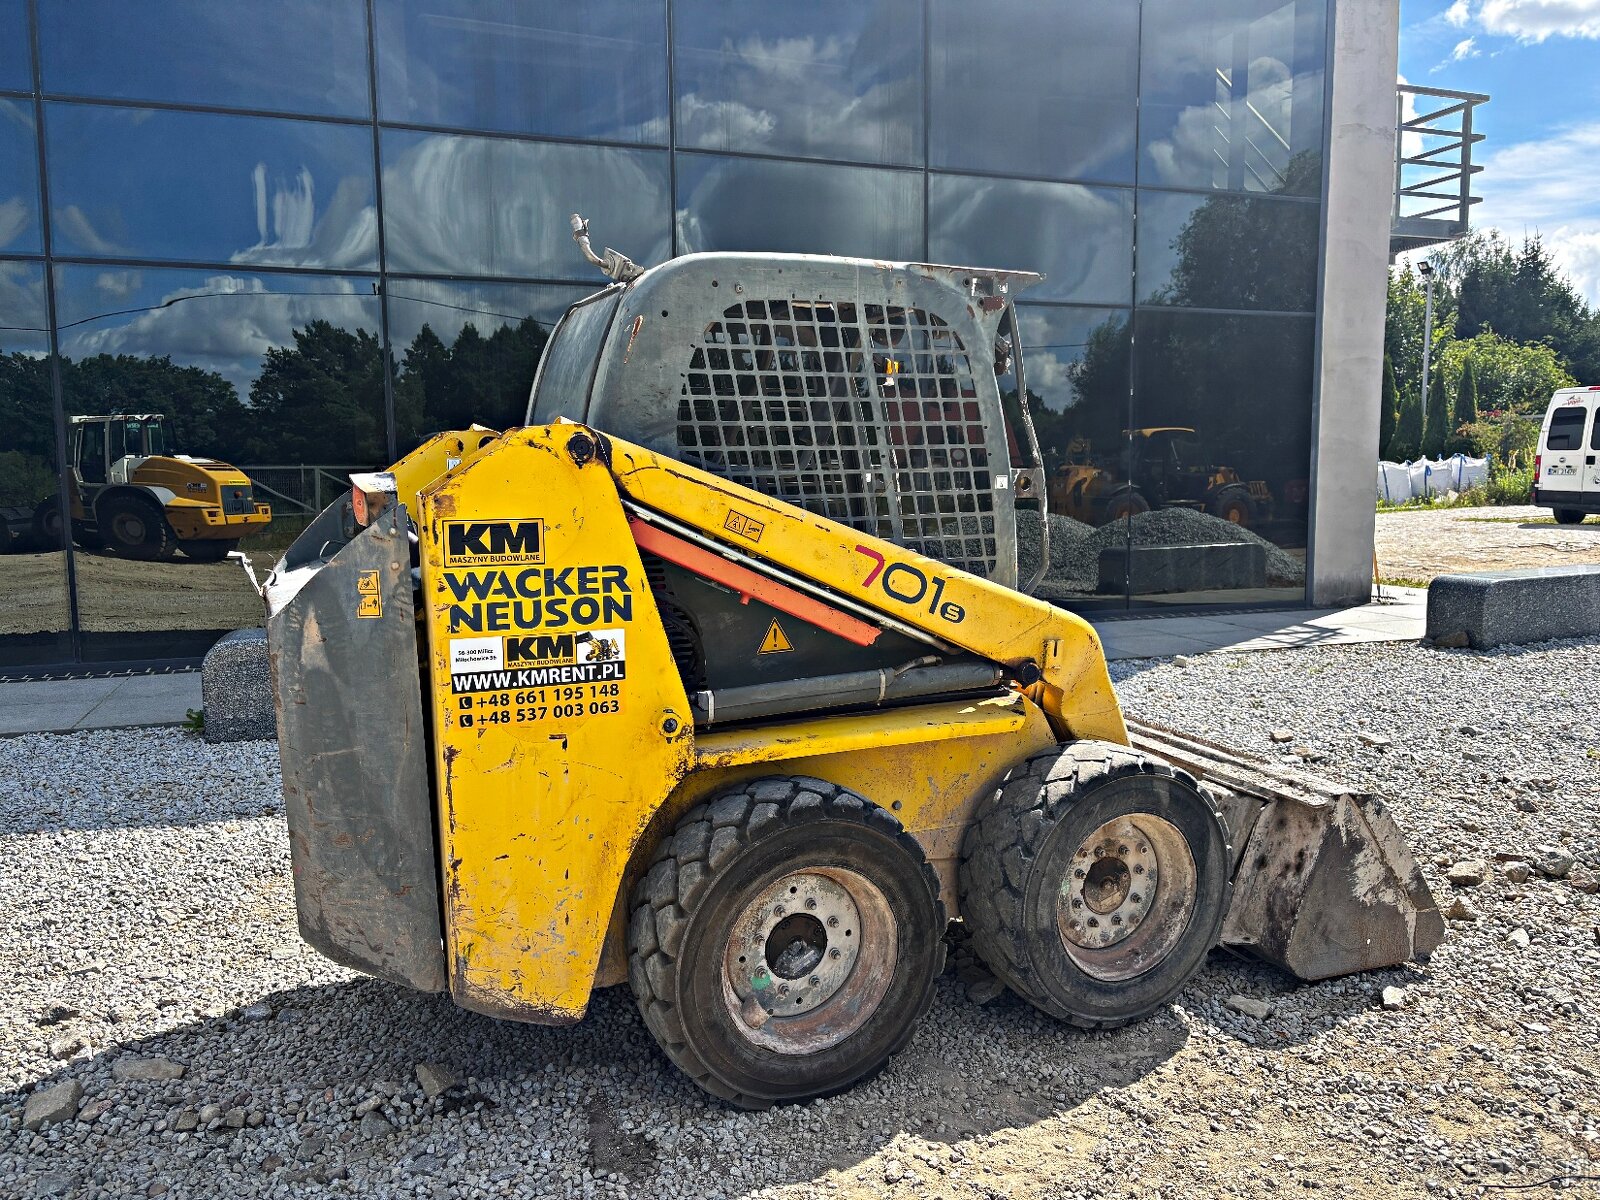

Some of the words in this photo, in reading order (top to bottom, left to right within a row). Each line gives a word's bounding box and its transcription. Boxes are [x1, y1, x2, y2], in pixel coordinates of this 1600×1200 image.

[448, 522, 540, 556] KM
[449, 556, 489, 564] MASZYNY
[489, 554, 540, 563] BUDOWLANE
[442, 565, 632, 602] WACKER
[450, 594, 633, 634] NEUSON
[506, 634, 574, 662] KM
[507, 660, 536, 668] MASZYNY
[536, 658, 574, 666] BUDOWLANE
[453, 663, 624, 692] WWW.KMRENT.PL
[476, 693, 510, 708] +48
[515, 690, 546, 705] 661
[553, 686, 584, 701] 195
[590, 683, 620, 698] 148
[476, 710, 511, 725] +48
[516, 706, 548, 722] 537
[553, 703, 584, 719] 003
[589, 700, 620, 715] 063
